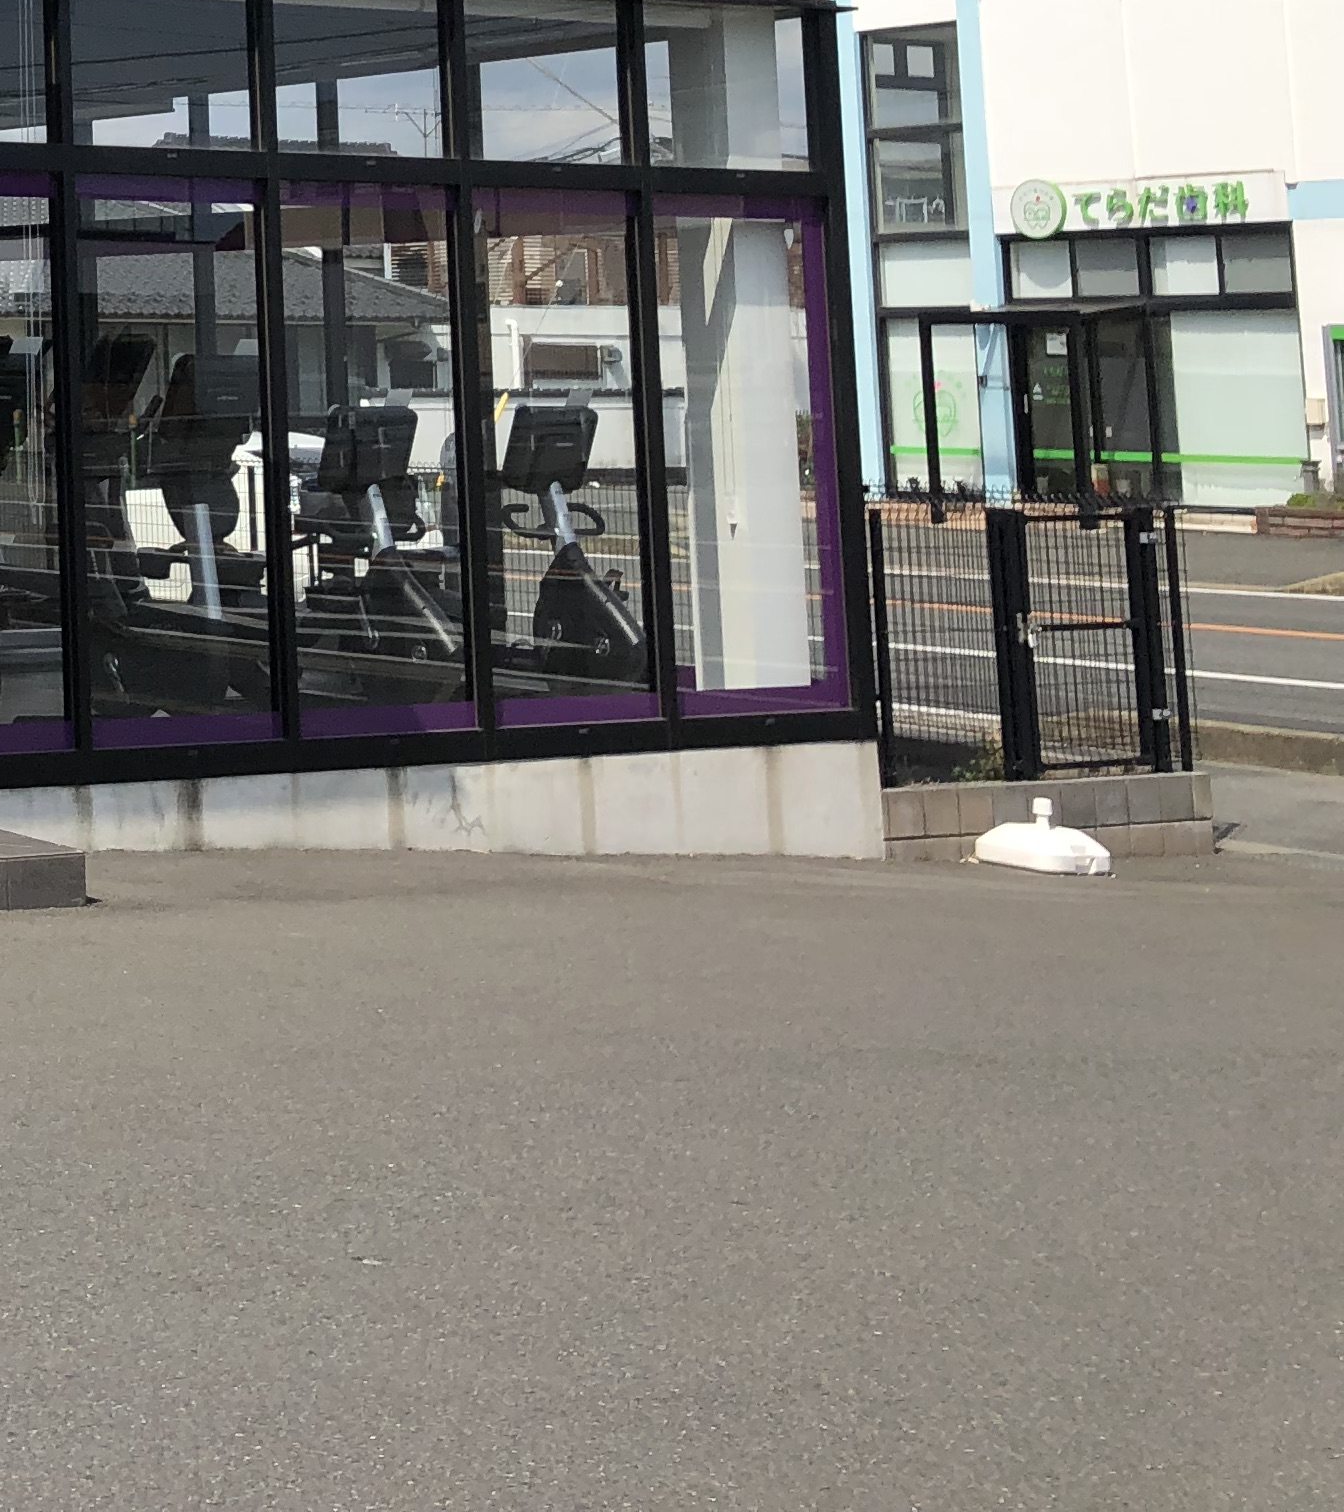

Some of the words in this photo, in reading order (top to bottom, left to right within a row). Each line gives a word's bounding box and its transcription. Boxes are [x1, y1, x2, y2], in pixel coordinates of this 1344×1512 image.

[1073, 180, 1249, 229] てらだ歯科
